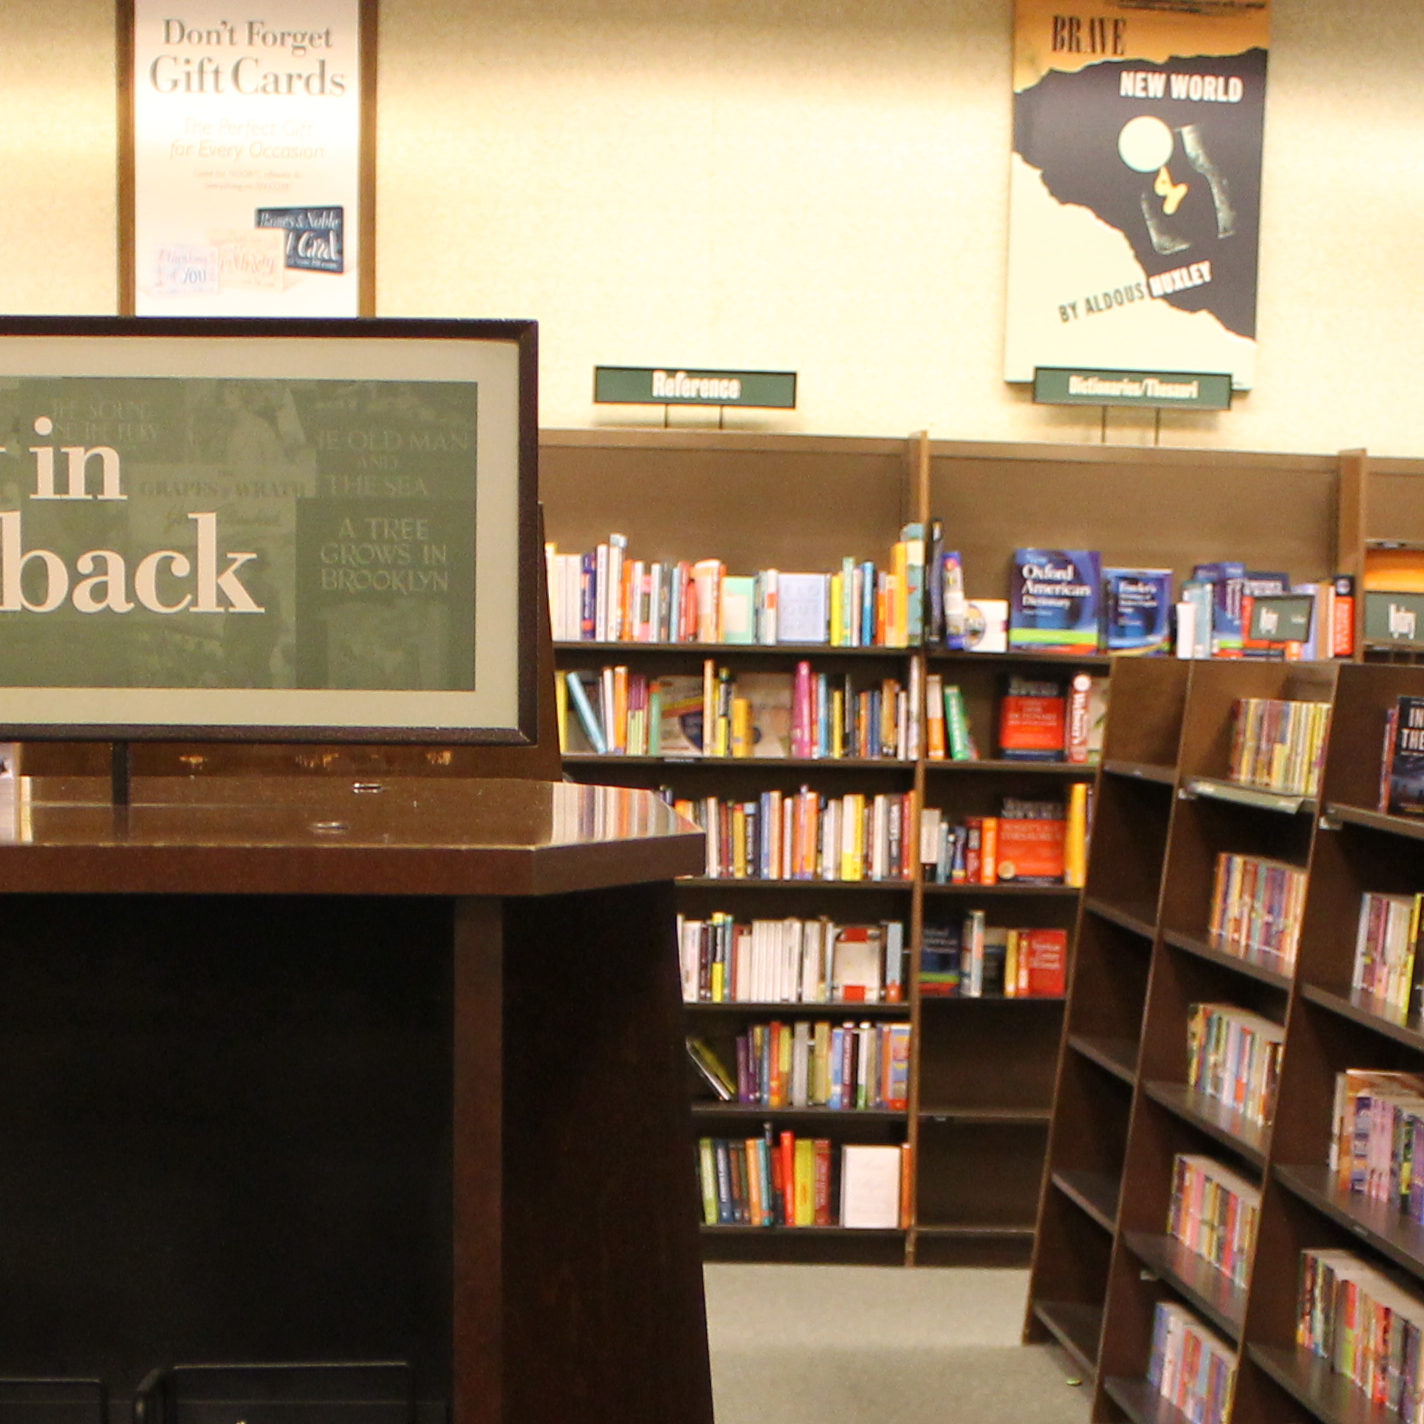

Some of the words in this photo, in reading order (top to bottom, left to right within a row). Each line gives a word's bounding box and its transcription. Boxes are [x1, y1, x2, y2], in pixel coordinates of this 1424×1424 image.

[163, 18, 237, 47] Don't
[246, 19, 332, 56] Forget
[1052, 15, 1127, 55] BRAVE
[149, 55, 225, 95] Gift
[230, 55, 346, 97] Cards
[1120, 71, 1166, 99] NEW
[1170, 74, 1244, 103] WORLD
[170, 139, 192, 161] for
[198, 141, 243, 162] Every
[250, 141, 325, 160] Occasion
[1058, 303, 1079, 323] BY
[1085, 282, 1145, 315] ALDOUS
[1149, 261, 1212, 298] HUXLEY
[651, 370, 741, 400] Reference
[410, 430, 469, 451] MAN
[28, 414, 129, 502] in
[384, 477, 429, 497] SEA
[338, 517, 356, 539] A
[364, 517, 430, 541] TREE
[319, 542, 413, 567] GROWS
[422, 543, 449, 566] IN
[320, 568, 449, 595] BROOKLYN
[1022, 562, 1075, 581] Oxford
[1021, 579, 1092, 597] American
[1022, 594, 1072, 610] Dictionary
